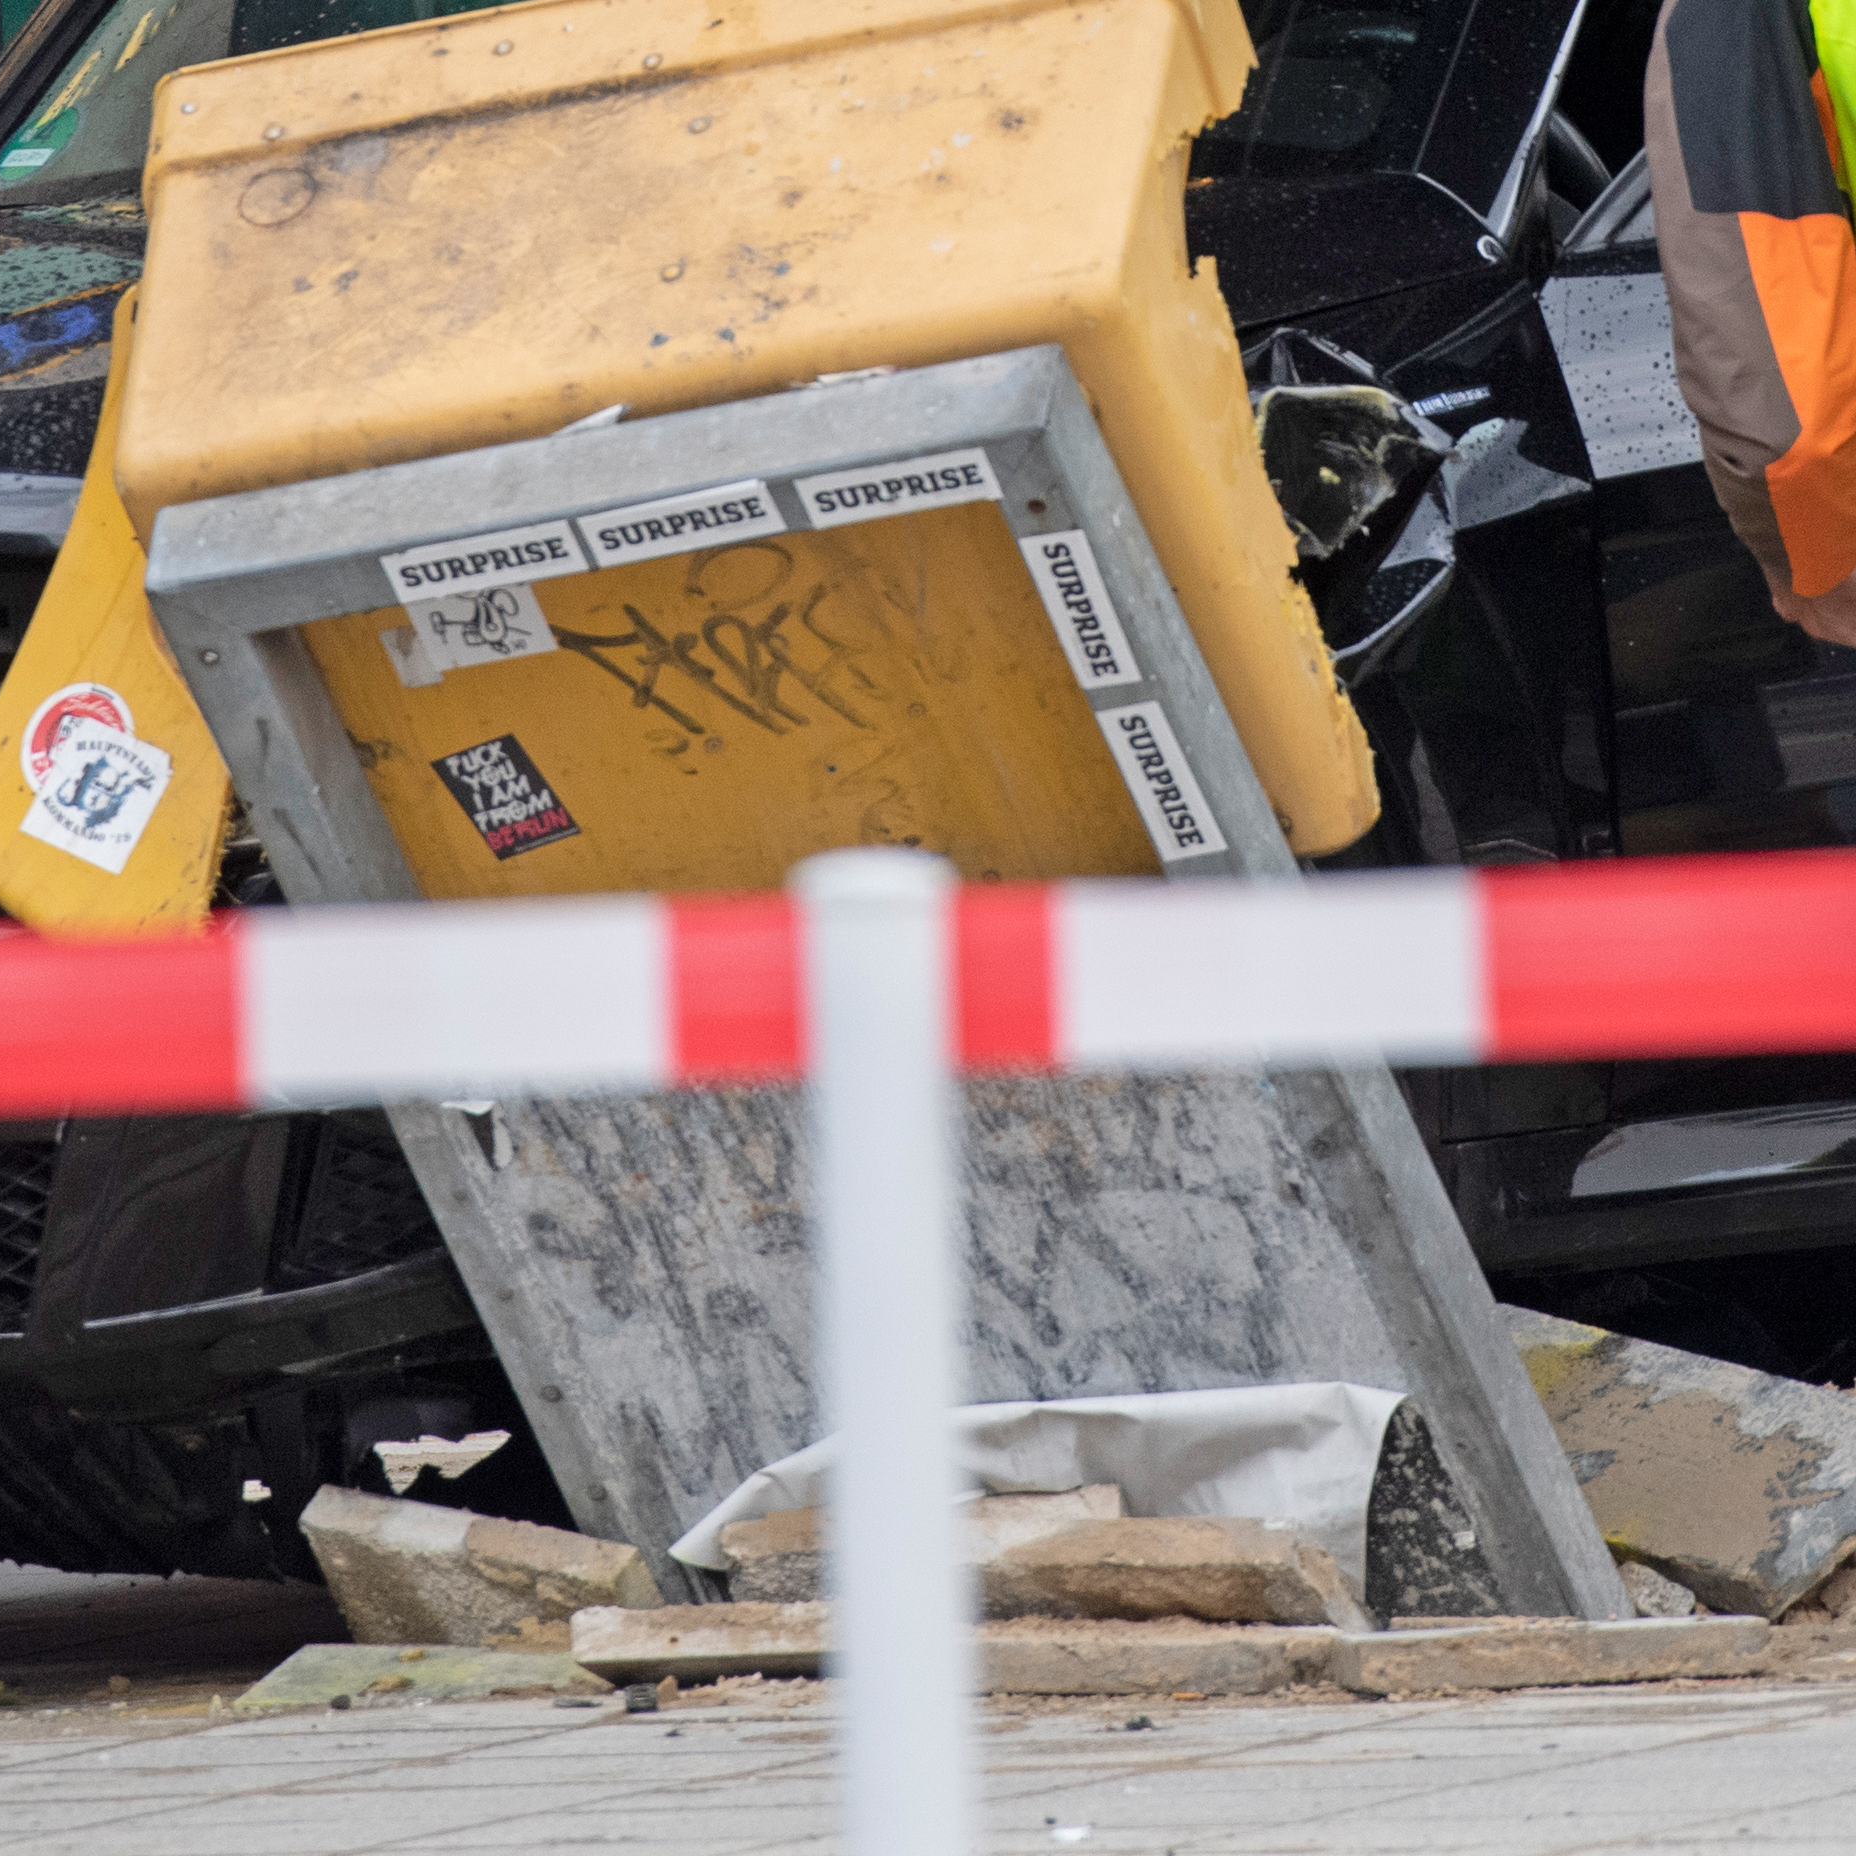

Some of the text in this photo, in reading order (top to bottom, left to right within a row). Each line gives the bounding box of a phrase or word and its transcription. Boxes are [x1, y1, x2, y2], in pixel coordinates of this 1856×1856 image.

[814, 463, 985, 514] SURPRISE
[597, 496, 768, 553] SURPRISE
[399, 537, 571, 589] SURPRISE
[1044, 542, 1119, 677] SURPRISE
[460, 758, 518, 791] YOU
[473, 774, 531, 811] I AM
[1120, 715, 1205, 848] SURPRISE
[487, 806, 569, 850] BERLIN
